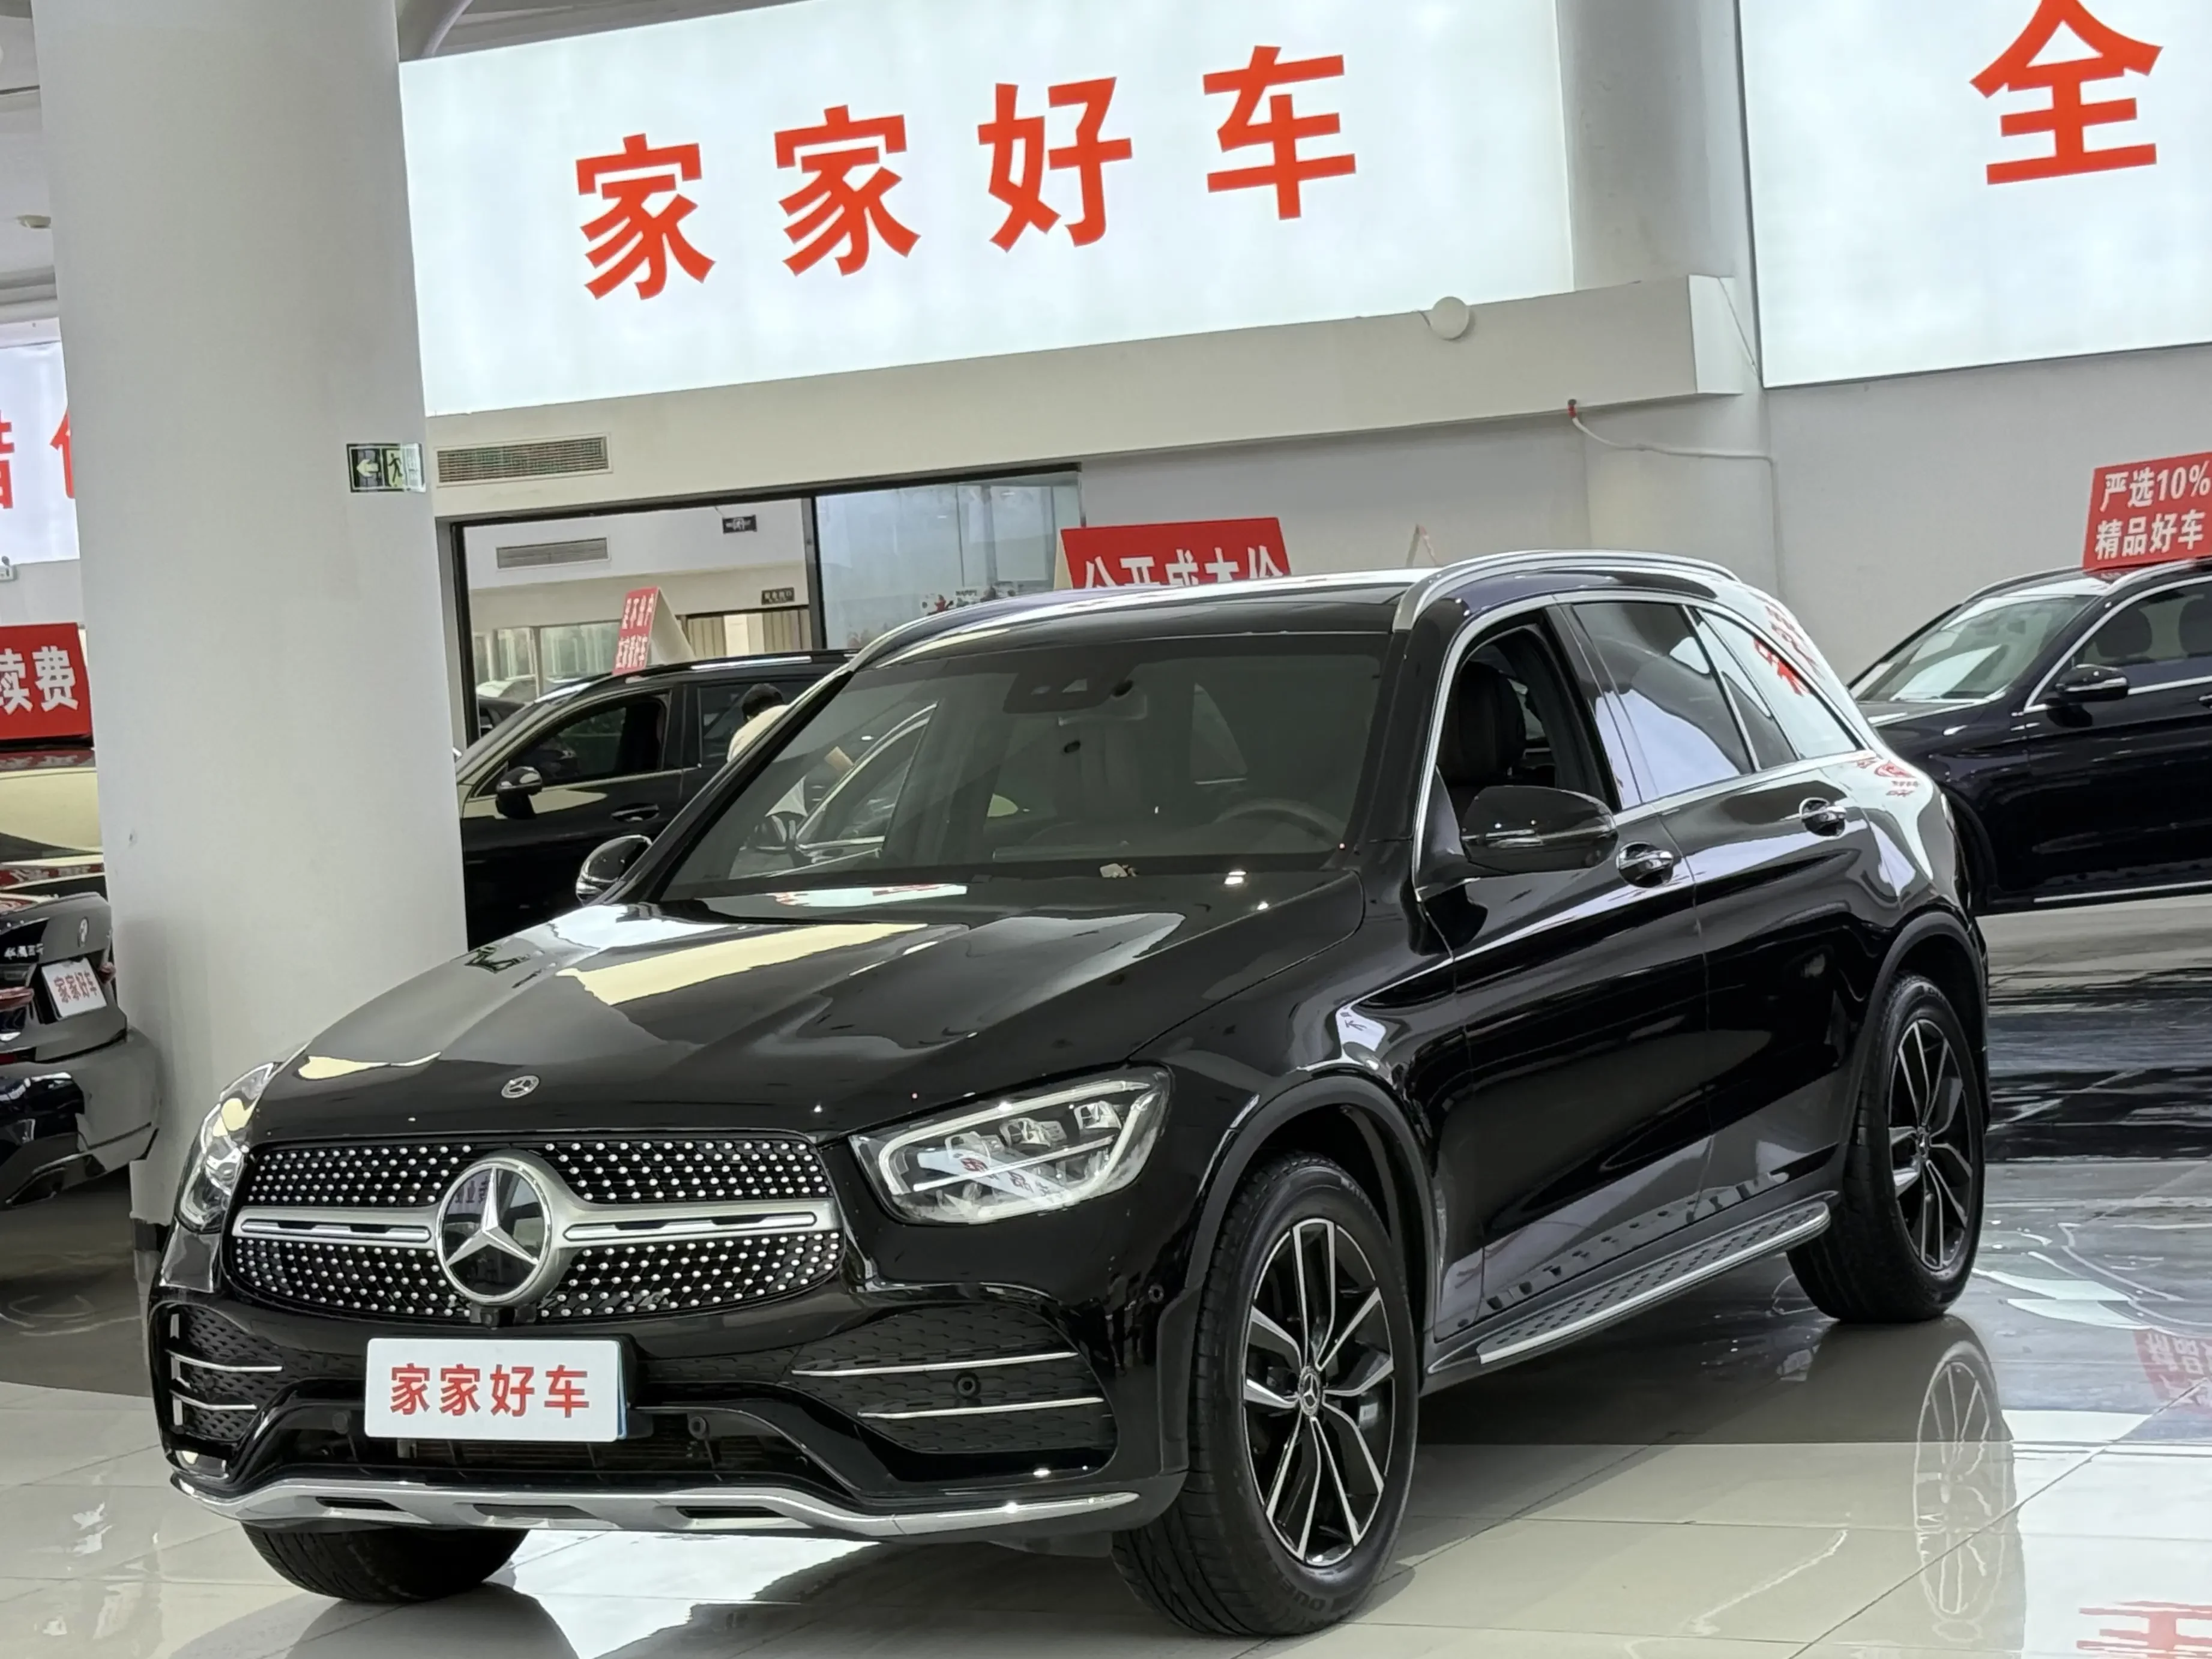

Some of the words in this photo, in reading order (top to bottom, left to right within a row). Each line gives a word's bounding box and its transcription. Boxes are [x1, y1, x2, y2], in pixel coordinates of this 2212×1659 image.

[1969, 0, 2163, 185] 全
[576, 45, 1356, 300] 家家好车
[2100, 459, 2211, 513] 严选10%
[2094, 508, 2206, 561] 精品好车
[53, 971, 98, 1004] 家家好车
[391, 1363, 589, 1418] 家家好车
